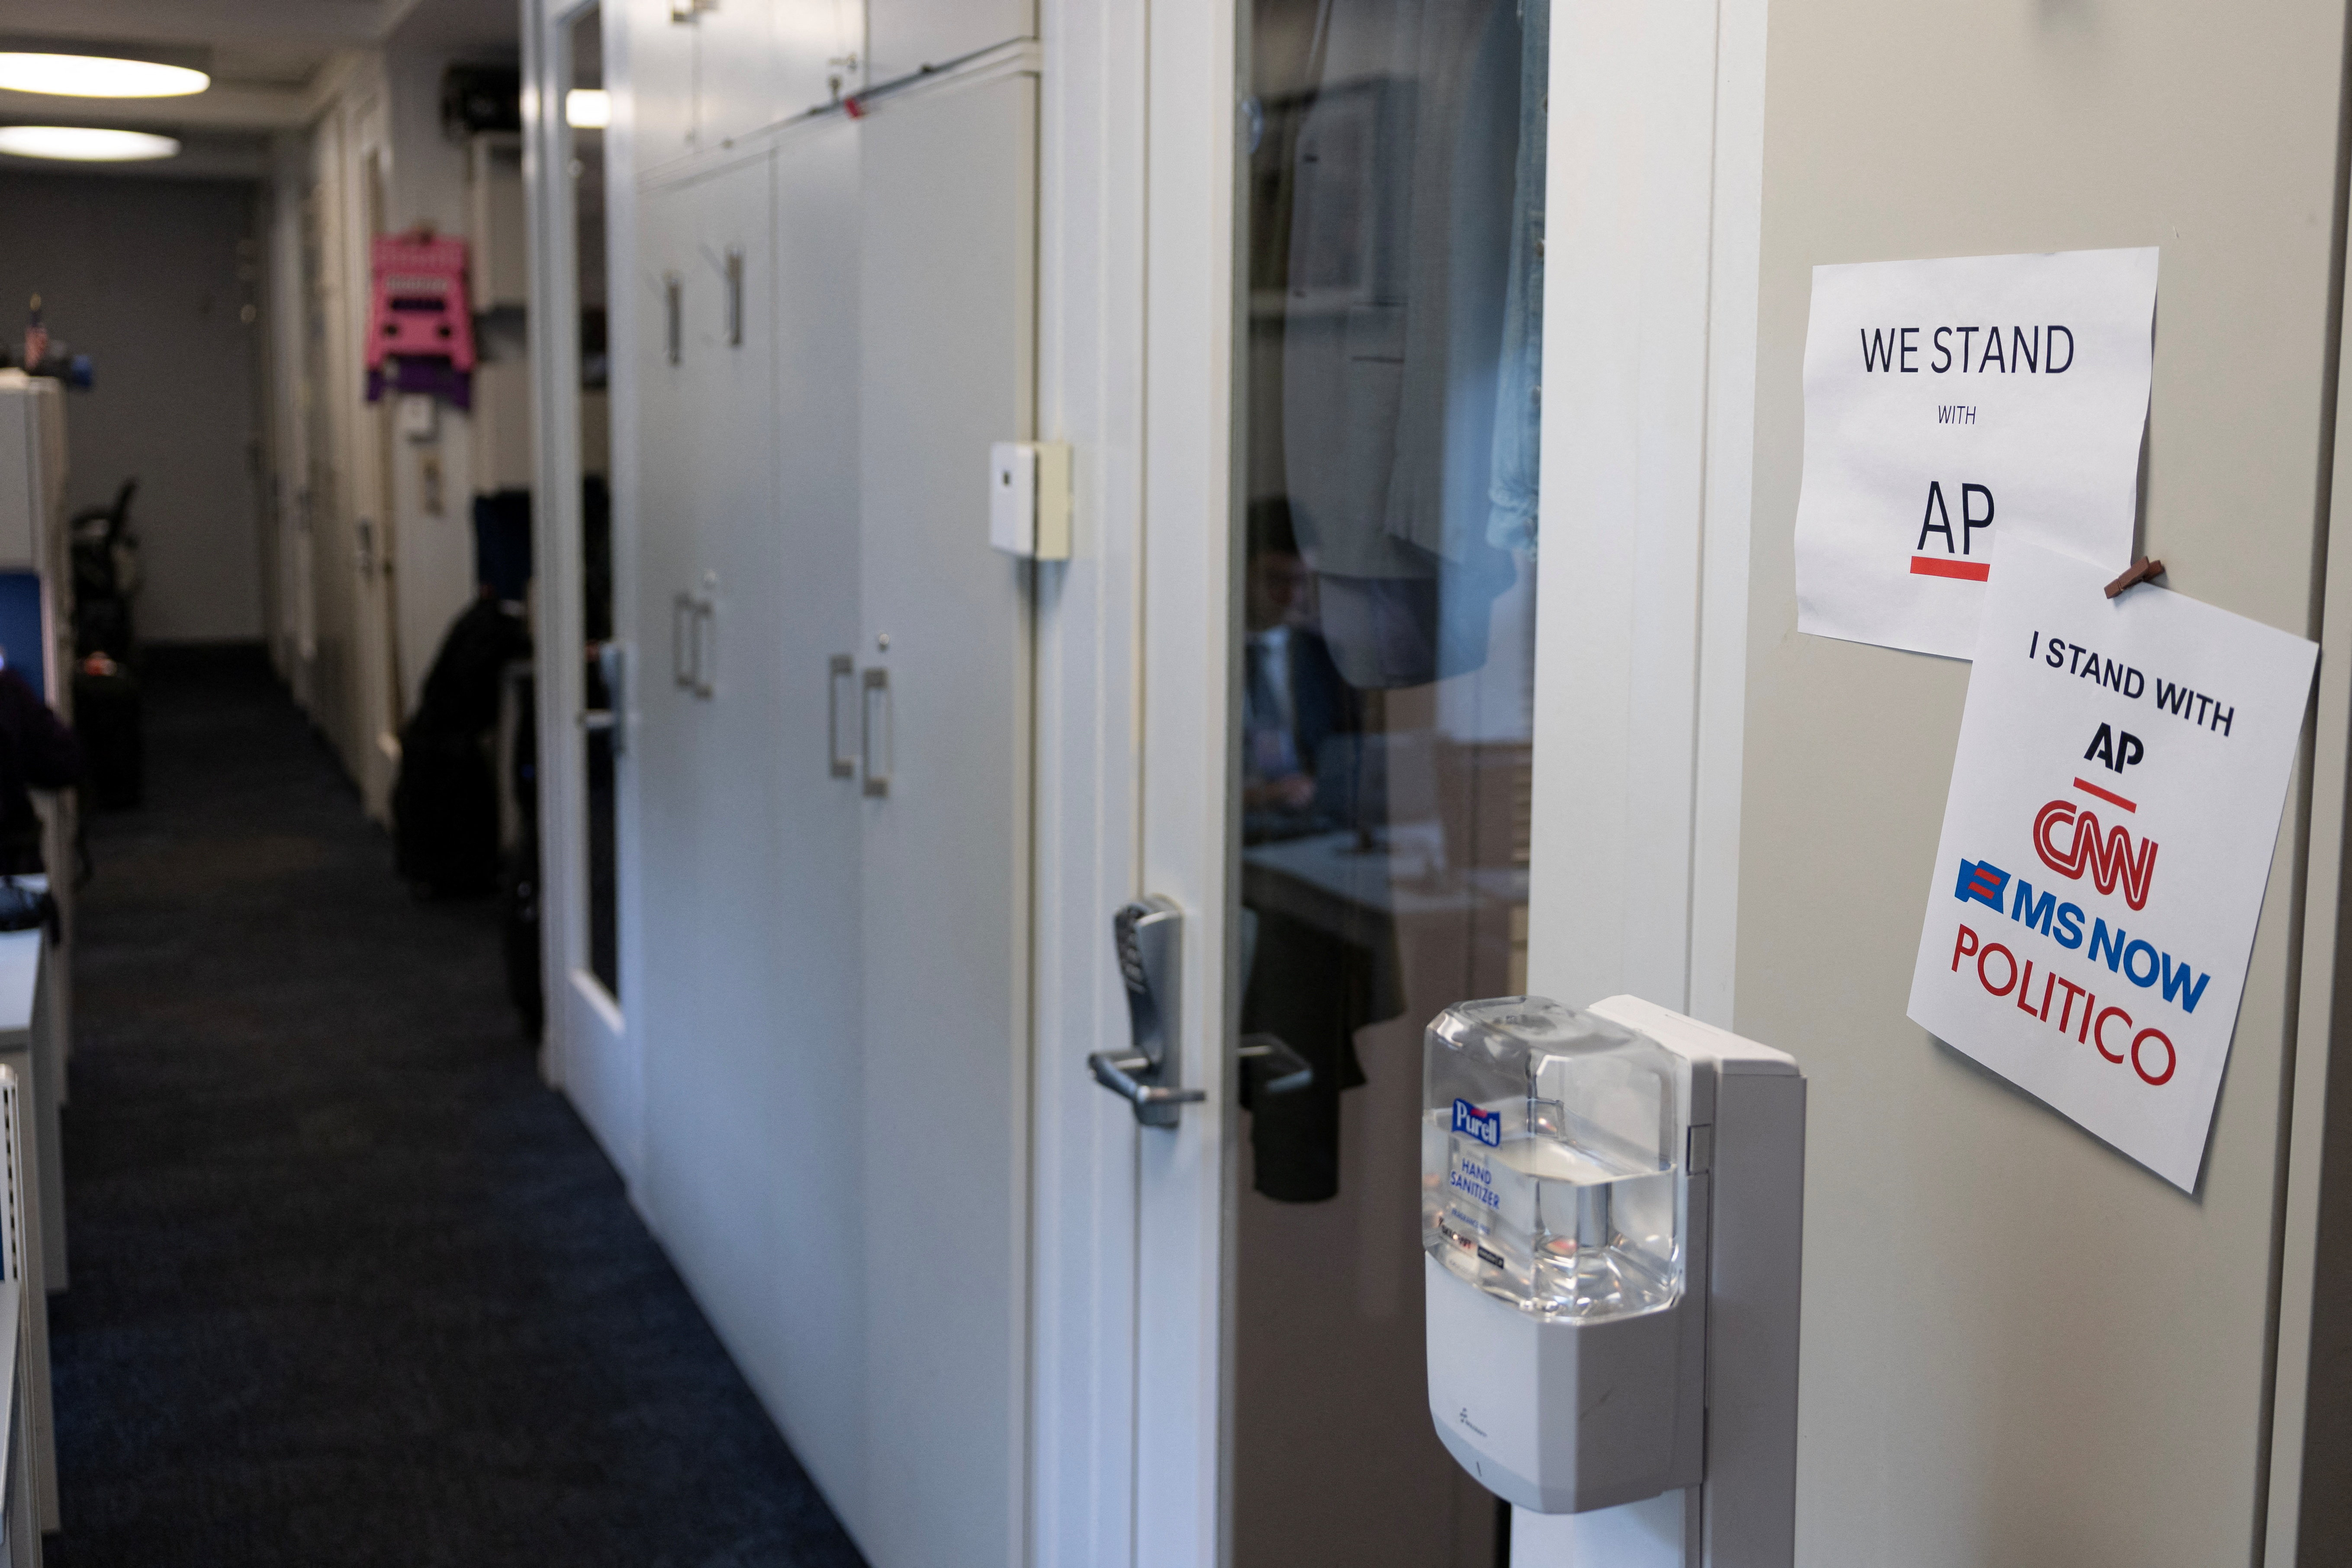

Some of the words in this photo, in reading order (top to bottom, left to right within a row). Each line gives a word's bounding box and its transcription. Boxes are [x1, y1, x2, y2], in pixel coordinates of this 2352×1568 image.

[1861, 328, 1920, 373] WE
[1931, 325, 2074, 373] STAND
[1938, 405, 1976, 425] WITH
[1917, 481, 1995, 555] AP
[2029, 631, 2039, 659] I
[2046, 638, 2145, 699] STAND
[2157, 678, 2234, 737] WITH
[2083, 722, 2144, 774] AP
[2033, 800, 2158, 911] CNN
[1951, 924, 2176, 1085] POLITICO
[1456, 1100, 1497, 1145] Purell
[1451, 1170, 1500, 1209] SANITIZER
[1462, 1158, 1492, 1185] HAND
